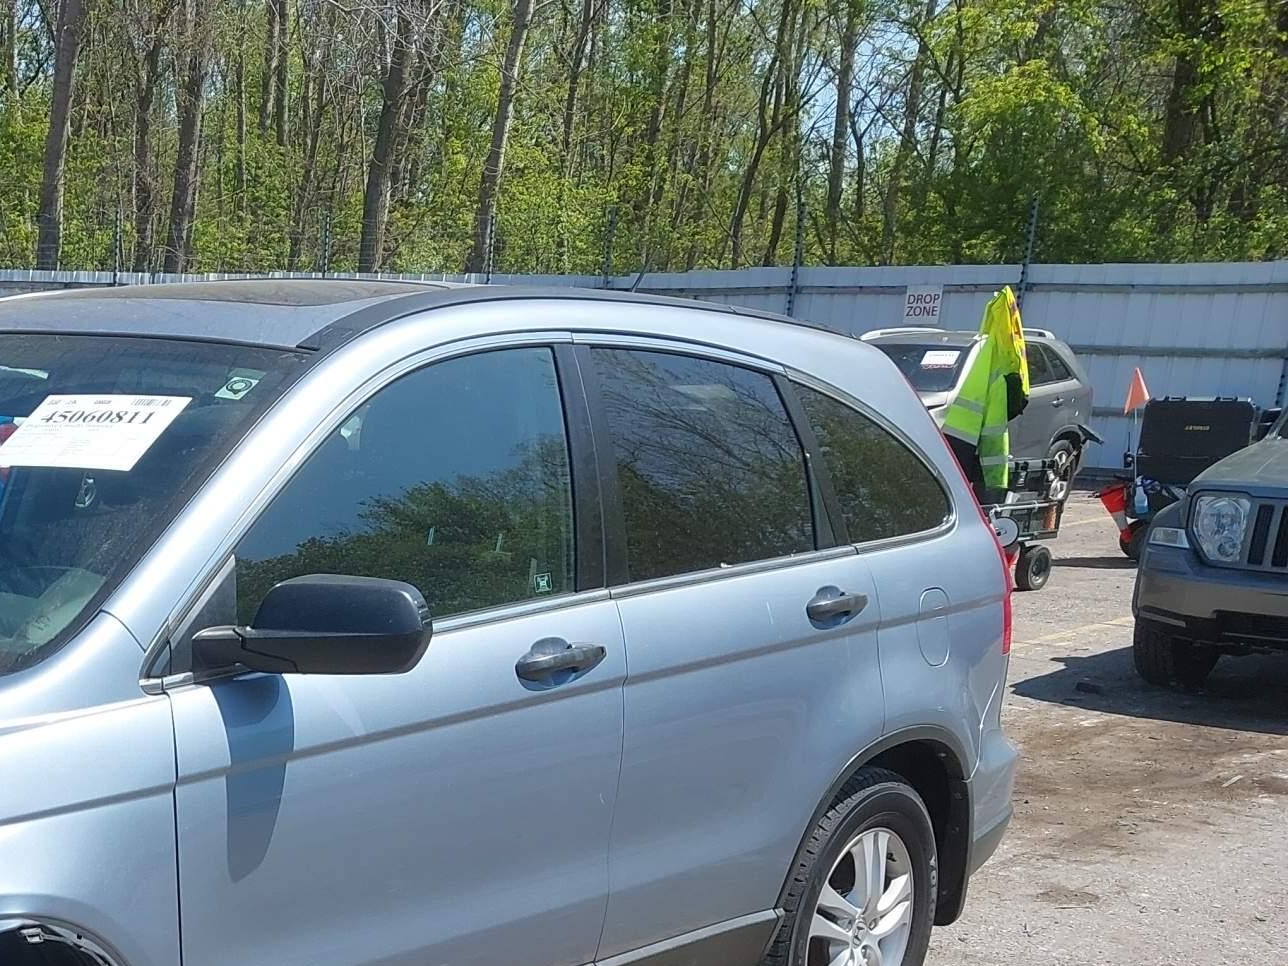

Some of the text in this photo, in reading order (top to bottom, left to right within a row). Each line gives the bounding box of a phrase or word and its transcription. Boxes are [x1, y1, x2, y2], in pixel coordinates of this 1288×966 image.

[907, 293, 941, 305] DROP
[905, 305, 938, 317] ZONE
[42, 410, 155, 424] 45060811
